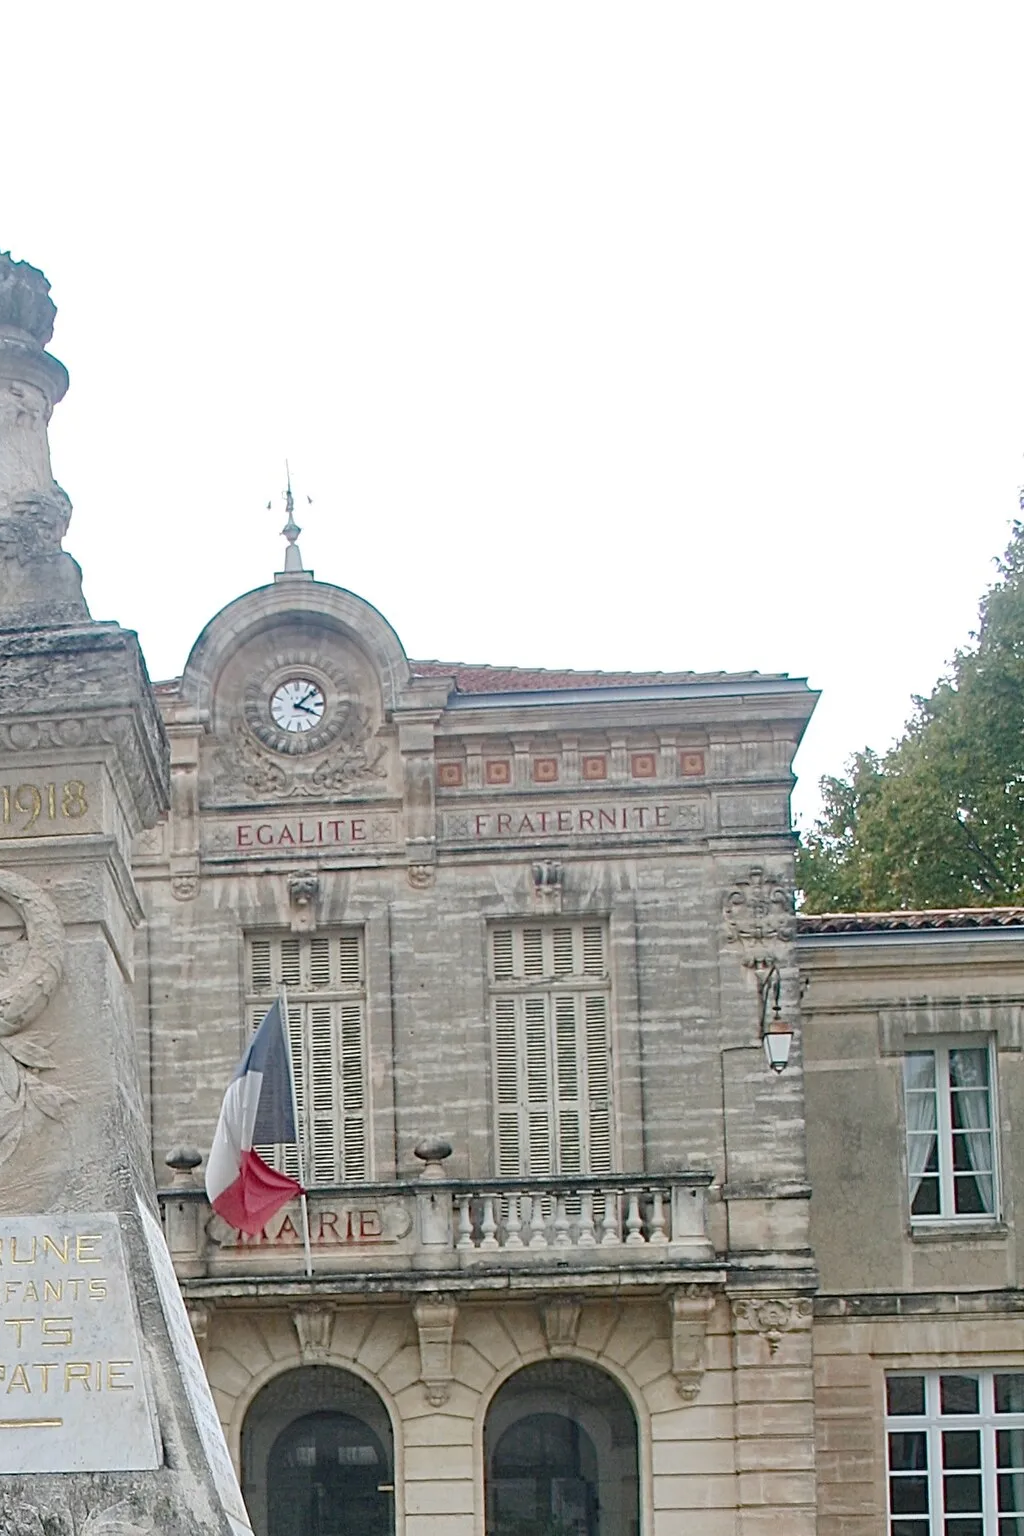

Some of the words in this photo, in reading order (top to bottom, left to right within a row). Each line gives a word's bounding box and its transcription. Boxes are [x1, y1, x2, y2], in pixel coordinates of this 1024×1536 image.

[0, 779, 89, 830] 1918
[237, 819, 367, 847] EGALITE
[476, 805, 672, 834] FRATERNITE
